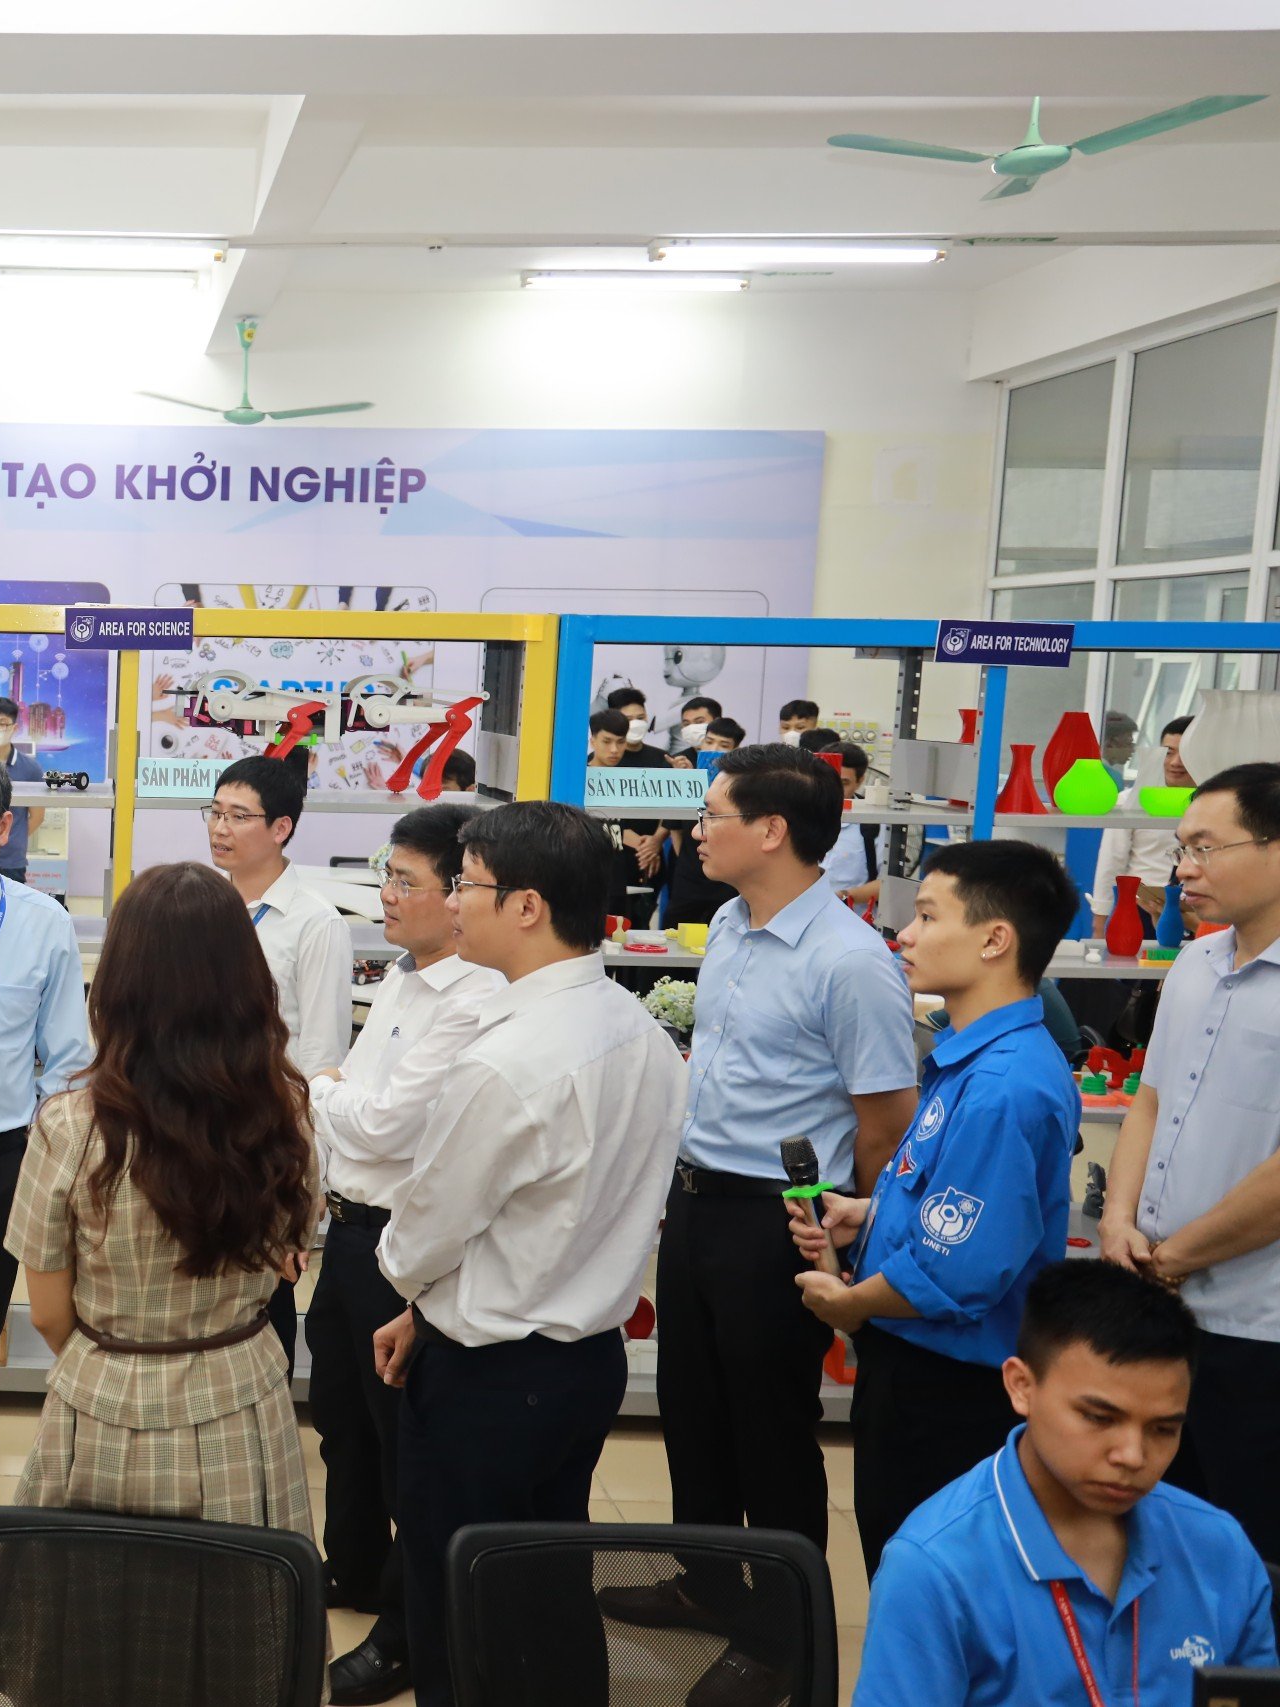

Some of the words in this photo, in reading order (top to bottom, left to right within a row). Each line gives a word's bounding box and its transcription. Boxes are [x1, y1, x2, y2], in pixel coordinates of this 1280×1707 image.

[1, 462, 97, 509] TẠO
[115, 451, 231, 502] KHỞI
[249, 456, 427, 515] NGHIỆP
[99, 621, 125, 636] AREA
[127, 621, 146, 636] FOR
[148, 621, 190, 636] SCIENCE
[970, 634, 993, 650] AREA
[994, 636, 1012, 650] FOR
[1014, 636, 1069, 653] TECHNOLOGY
[142, 761, 169, 787] SẢN
[173, 760, 211, 787] PHẨM
[587, 772, 616, 797] SẢN
[620, 769, 663, 798] PHẨM
[666, 779, 682, 798] IN
[686, 780, 703, 799] 3D
[922, 1236, 950, 1256] UNETI
